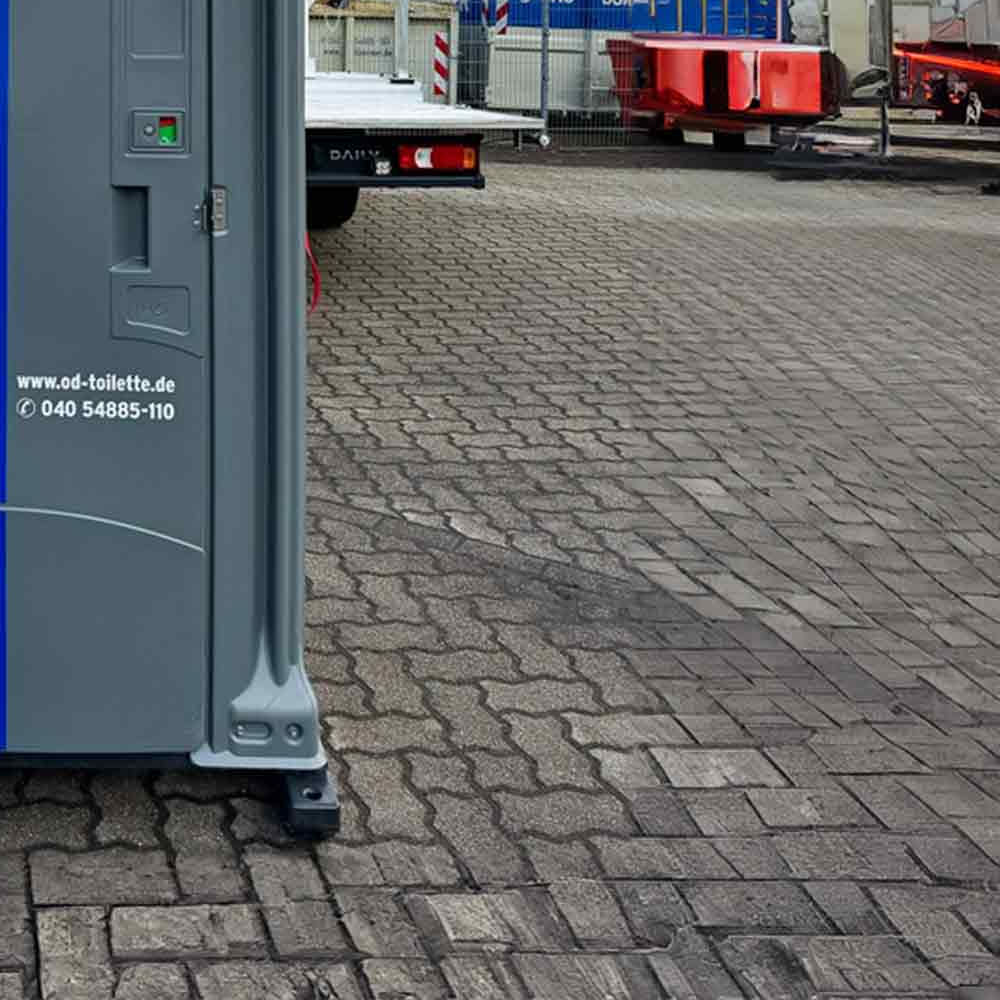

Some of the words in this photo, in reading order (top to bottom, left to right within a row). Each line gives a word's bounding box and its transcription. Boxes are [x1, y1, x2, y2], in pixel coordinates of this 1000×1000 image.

[16, 373, 175, 393] www.od-toilette.de
[41, 400, 77, 417] 040
[82, 401, 175, 420] 54885-110
